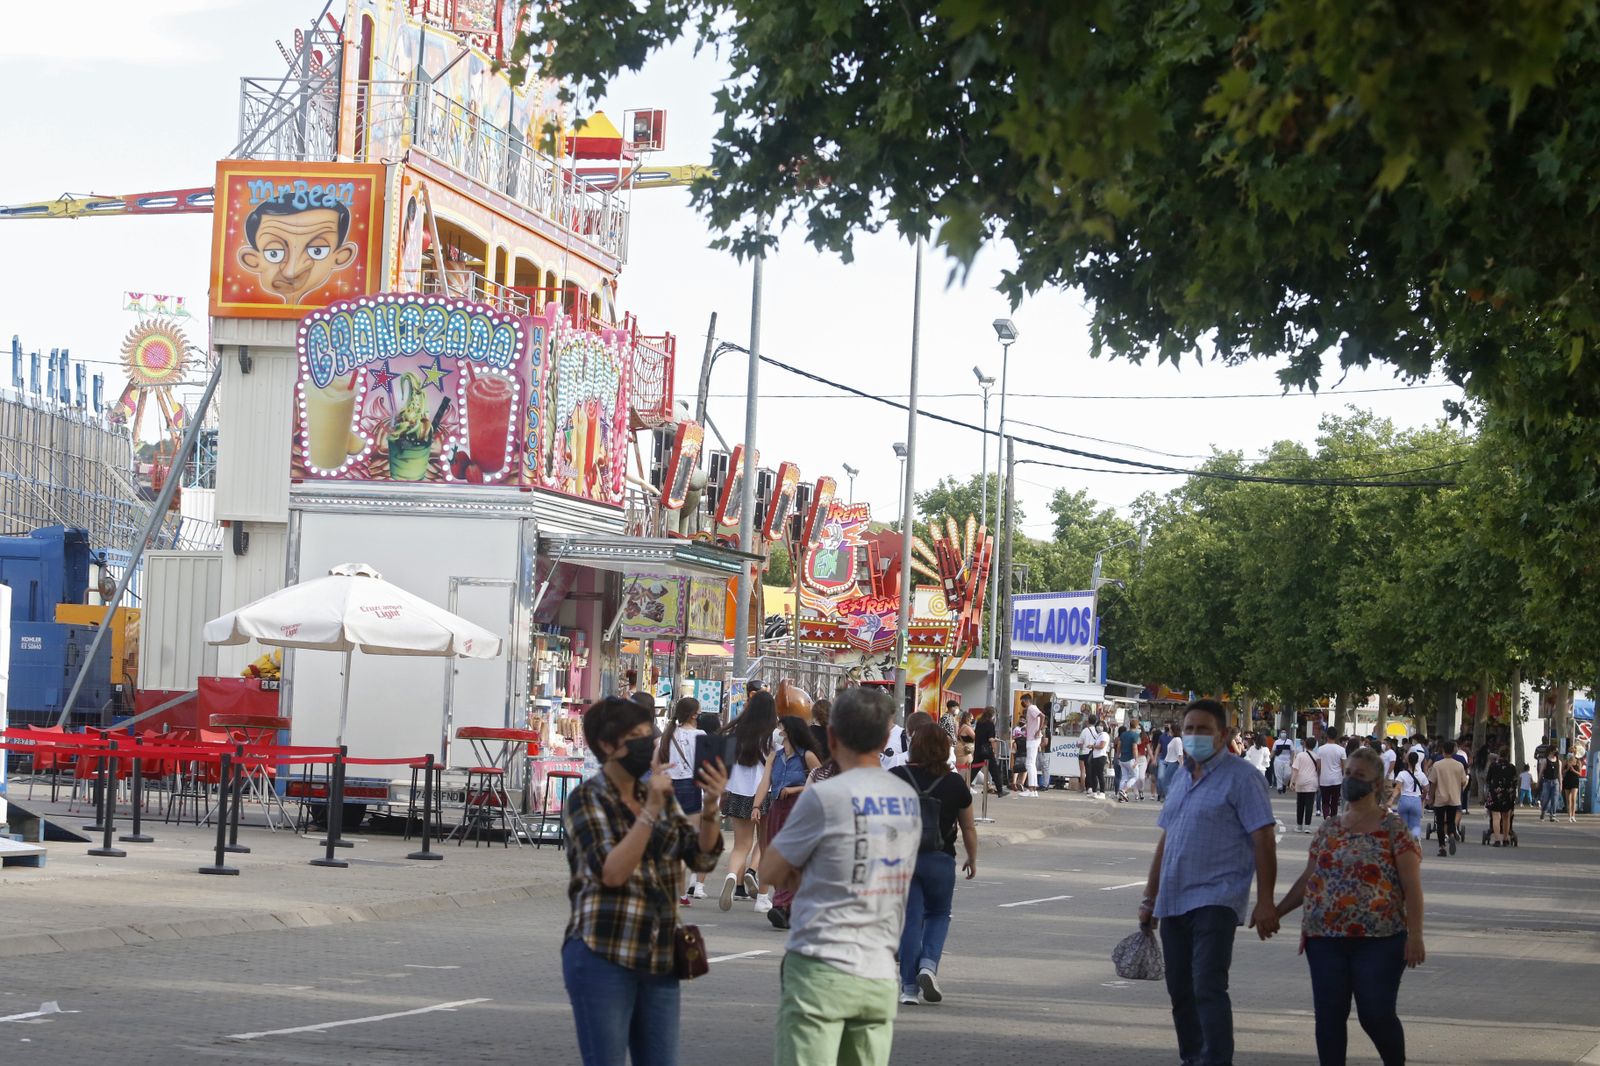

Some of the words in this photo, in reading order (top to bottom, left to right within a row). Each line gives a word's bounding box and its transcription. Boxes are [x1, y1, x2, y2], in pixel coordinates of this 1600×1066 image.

[292, 180, 355, 210] Bean
[308, 303, 515, 388] GRANIZADA
[527, 326, 543, 471] HELADOS
[375, 609, 401, 620] Light
[1013, 607, 1091, 646] HELADOS
[851, 796, 901, 816] SAFE
